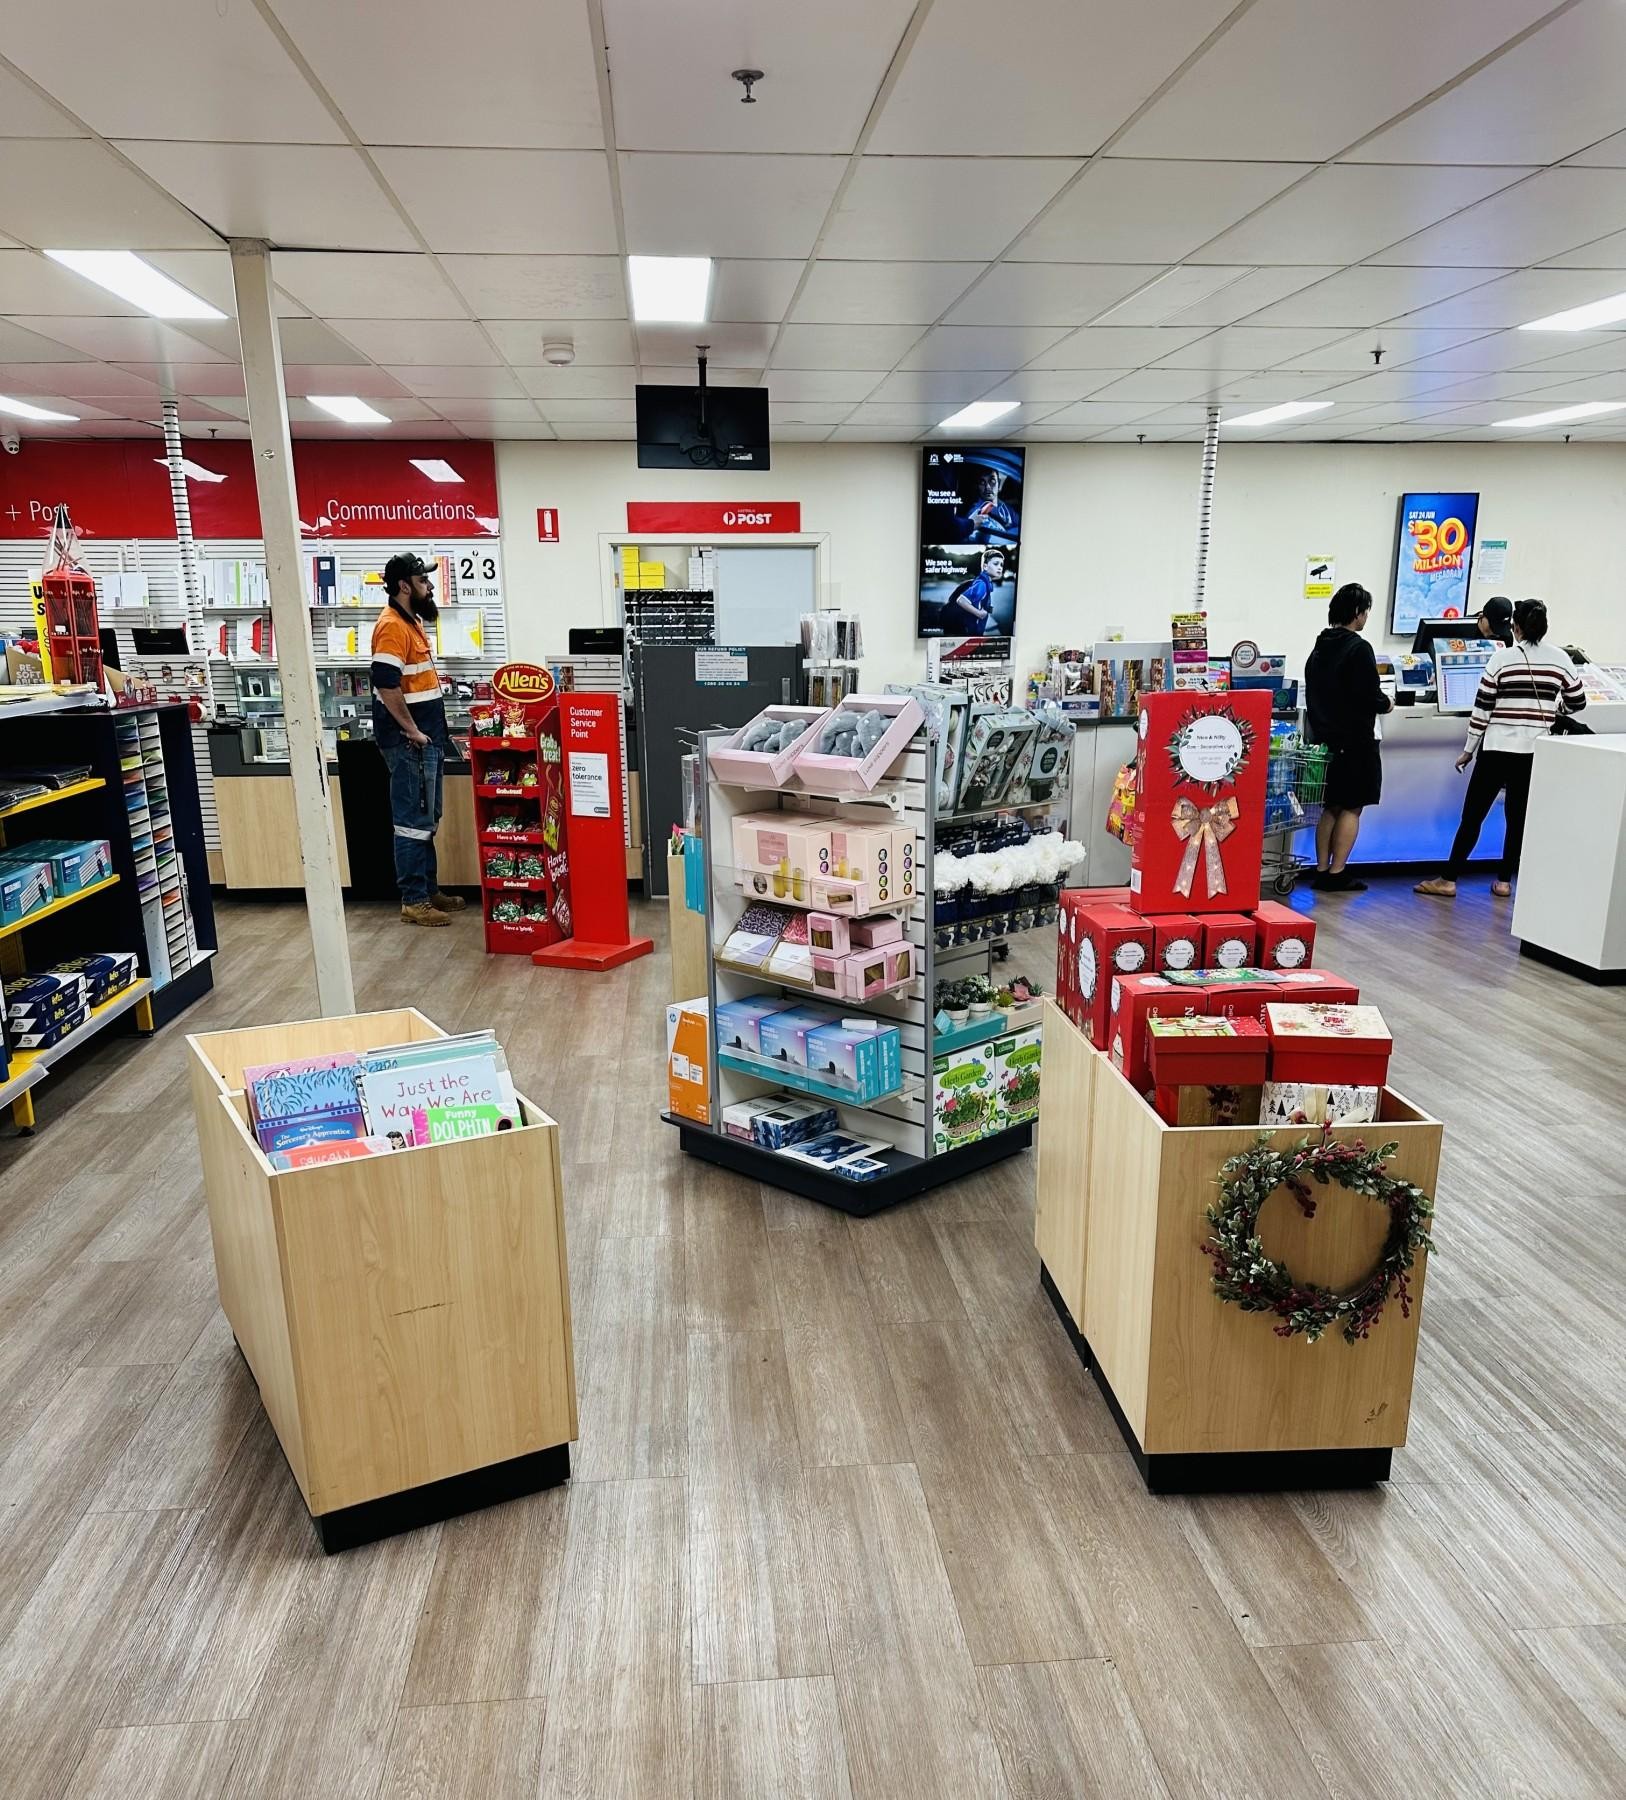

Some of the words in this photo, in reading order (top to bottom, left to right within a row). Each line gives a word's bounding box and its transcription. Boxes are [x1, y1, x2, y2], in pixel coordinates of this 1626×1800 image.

[927, 489, 939, 497] You
[927, 496, 949, 504] licence
[327, 499, 475, 520] Communications
[1409, 511, 1418, 519] SAT
[1418, 511, 1425, 519] 24
[1425, 511, 1436, 519] JUN
[737, 513, 772, 525] POST
[1413, 554, 1463, 573] MILLION
[462, 587, 475, 596] FRI
[16, 670, 40, 679] SOFT
[498, 671, 549, 692] Allen's
[569, 706, 602, 717] Customer
[570, 717, 596, 728] Service
[571, 728, 588, 739] Point
[540, 732, 554, 749] Grab
[543, 745, 560, 763] treat!
[572, 772, 603, 781] tolerance
[547, 853, 562, 868] Have
[943, 1073, 959, 1086] Herb
[960, 1068, 981, 1081] Garden
[396, 1077, 435, 1098] Just
[439, 1072, 469, 1090] the
[426, 1094, 455, 1108] We
[462, 1087, 491, 1105] Are
[445, 1108, 476, 1120] Funny
[432, 1116, 490, 1141] DOLPHIN
[276, 1133, 311, 1149] Sorcerer's
[312, 1128, 352, 1139] Apprentice
